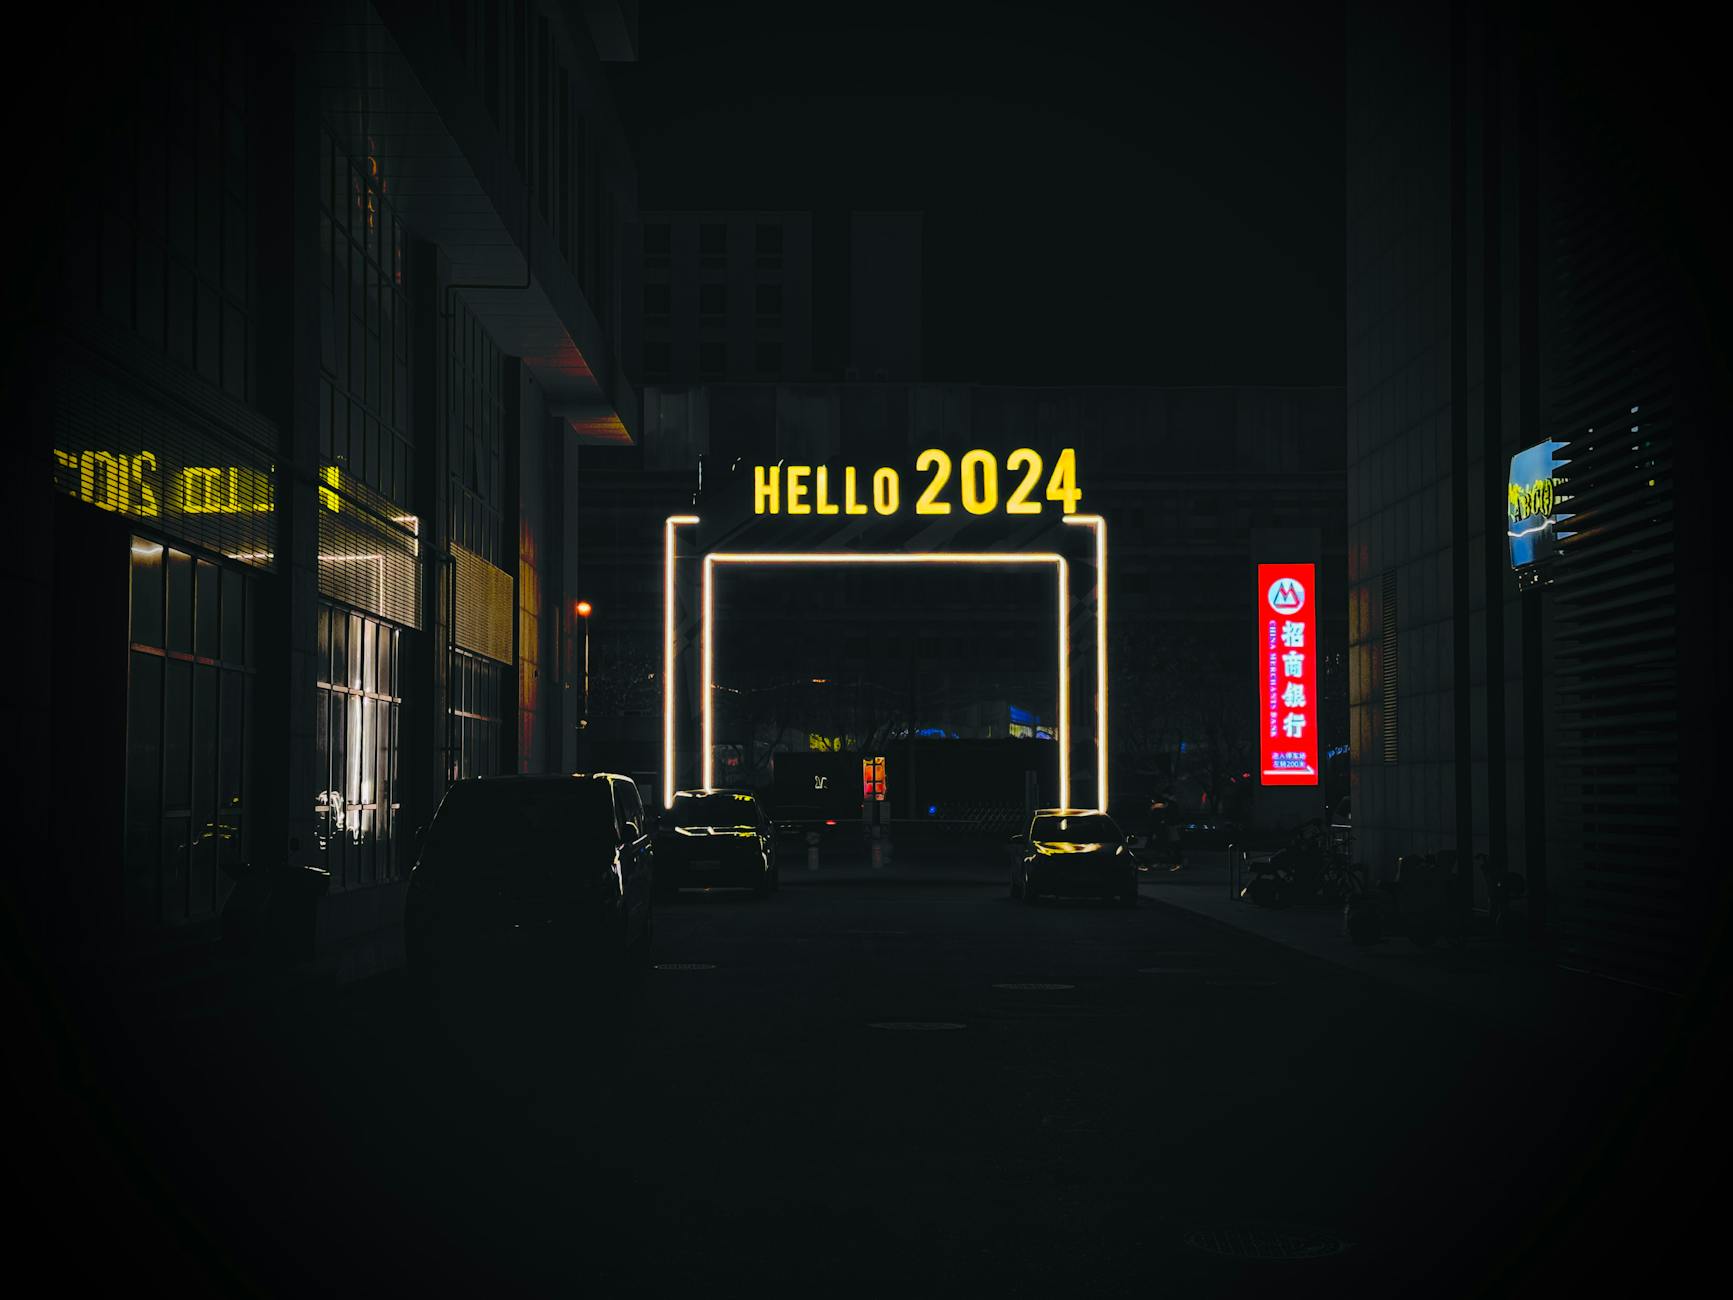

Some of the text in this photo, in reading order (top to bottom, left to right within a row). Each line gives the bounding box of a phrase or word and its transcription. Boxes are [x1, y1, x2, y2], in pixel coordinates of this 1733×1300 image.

[754, 448, 1082, 515] HELLO 2024
[1281, 620, 1306, 739] 招商银行
